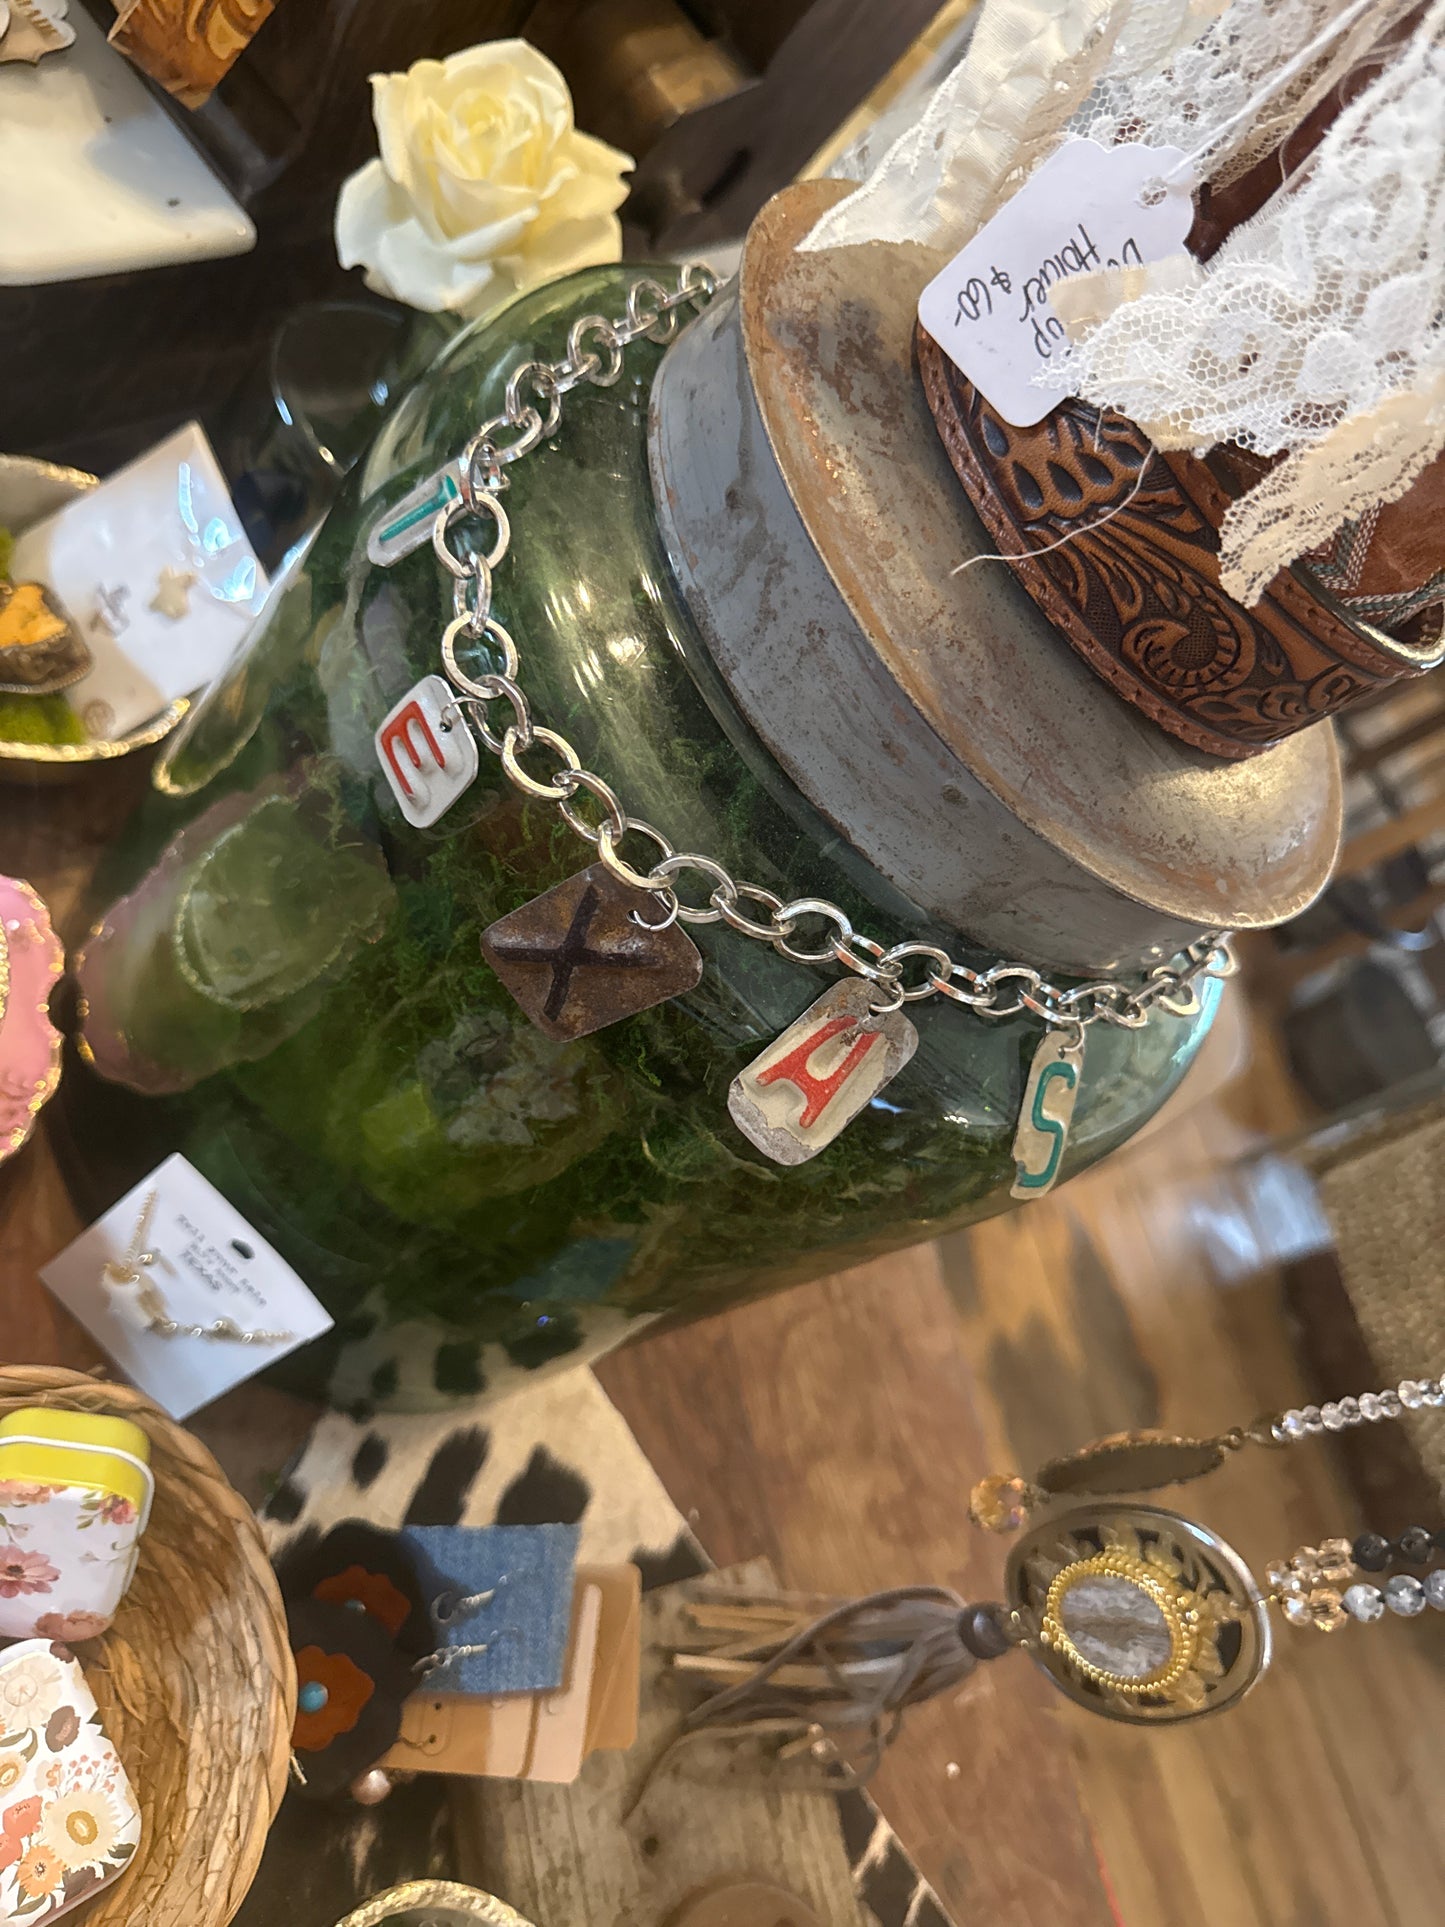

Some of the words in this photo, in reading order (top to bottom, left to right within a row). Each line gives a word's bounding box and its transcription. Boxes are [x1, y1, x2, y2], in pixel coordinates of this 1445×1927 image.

[380, 700, 446, 796] E
[493, 883, 663, 1022] X
[756, 1015, 882, 1130] A
[1016, 1061, 1075, 1188] S
